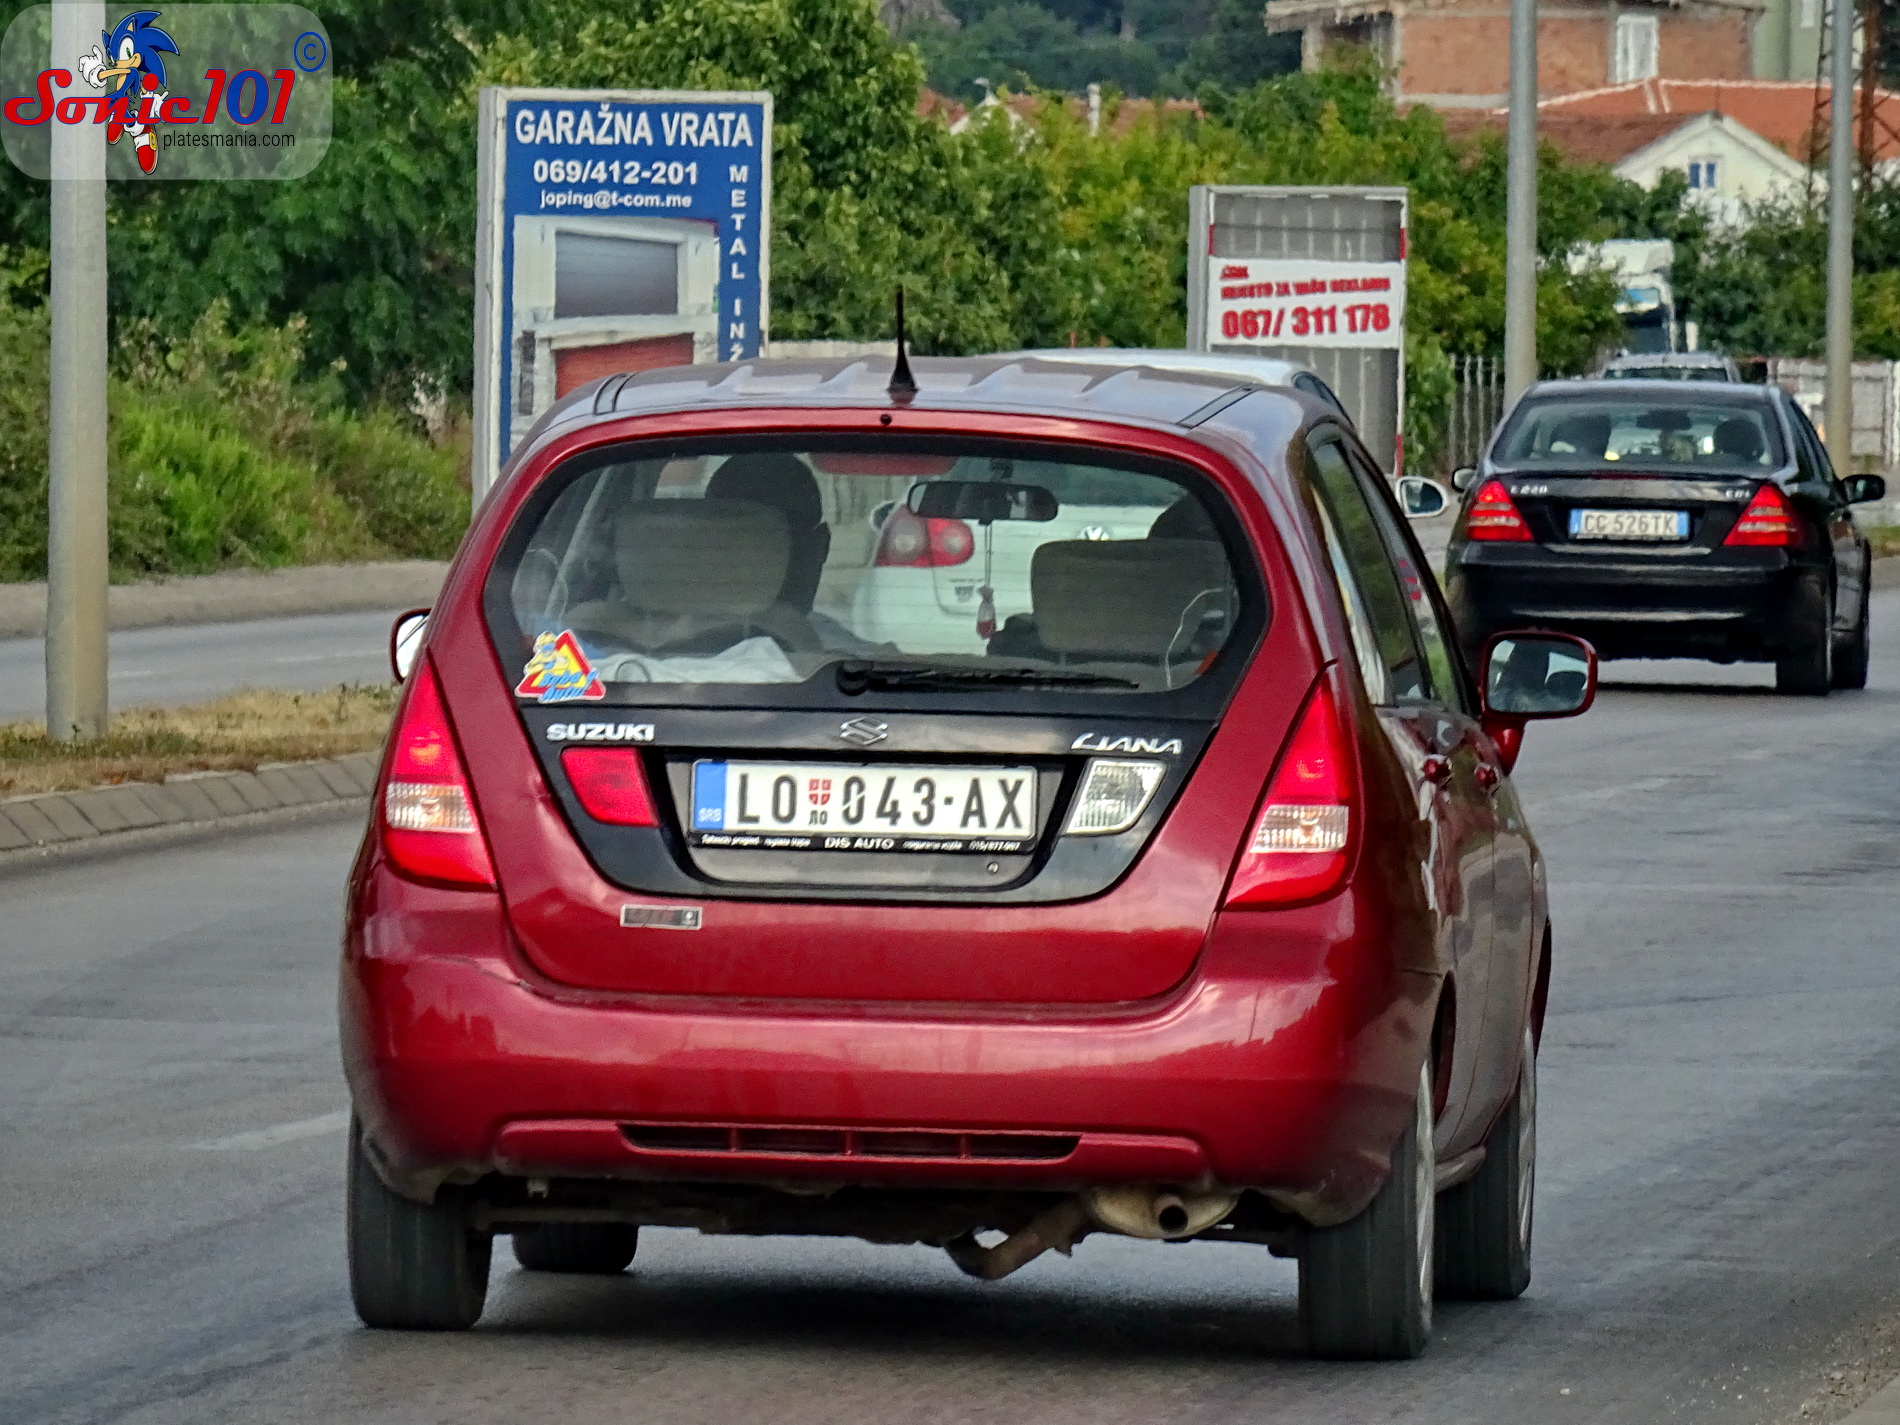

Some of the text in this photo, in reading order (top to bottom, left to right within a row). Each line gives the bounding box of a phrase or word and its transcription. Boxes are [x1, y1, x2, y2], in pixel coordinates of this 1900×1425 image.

[515, 103, 754, 147] GARAŽNA VRATA
[533, 160, 698, 185] 069/412-201
[540, 189, 692, 208] joping@t-com.me
[729, 165, 748, 279] METAL
[1221, 303, 1390, 338] 067/ 311 178
[546, 723, 655, 742] SUZUKI
[1070, 731, 1183, 755] LIANA
[737, 773, 797, 824] LO
[824, 837, 851, 849] DIS
[853, 838, 895, 850] AUTO
